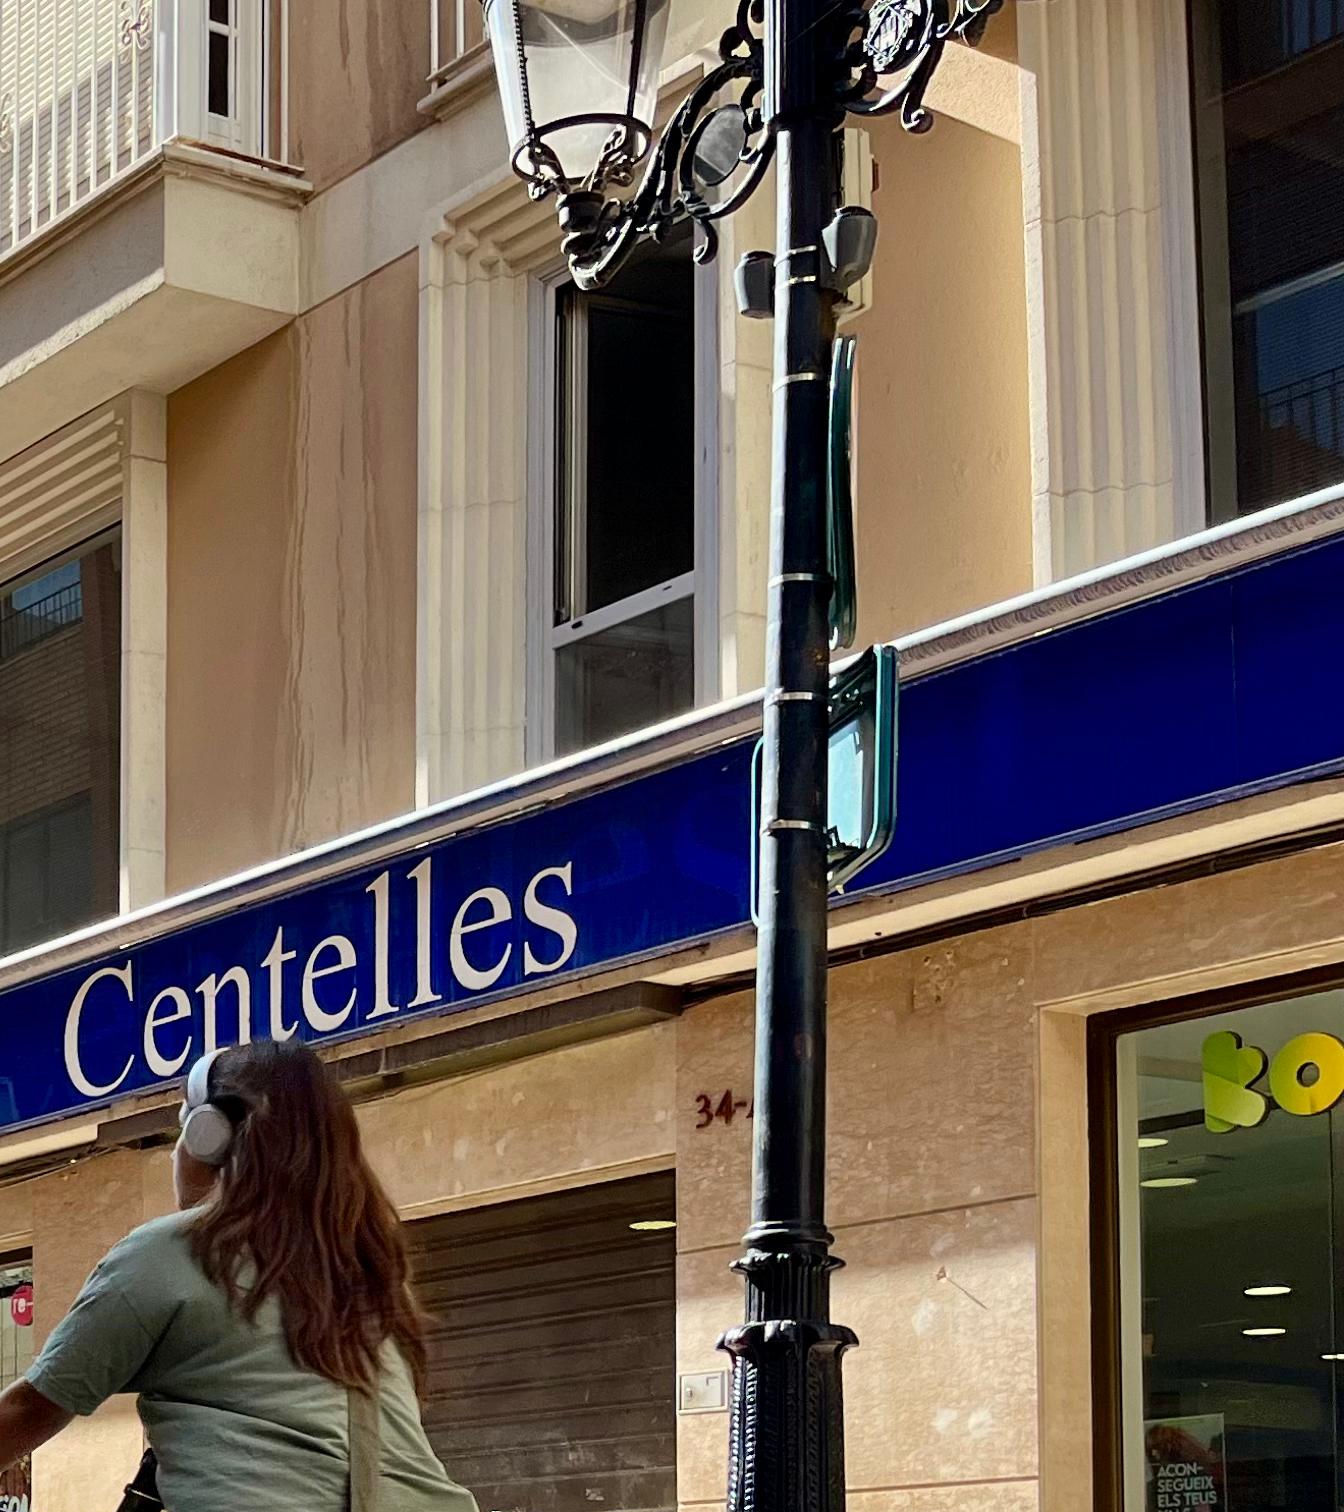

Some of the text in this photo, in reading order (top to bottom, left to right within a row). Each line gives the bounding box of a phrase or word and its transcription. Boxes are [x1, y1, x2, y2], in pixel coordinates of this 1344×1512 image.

[64, 857, 578, 1098] Centelles
[1157, 1462, 1204, 1478] ACON-
[1157, 1476, 1214, 1493] SEGUEIX
[1157, 1491, 1217, 1508] ELS TEUS
